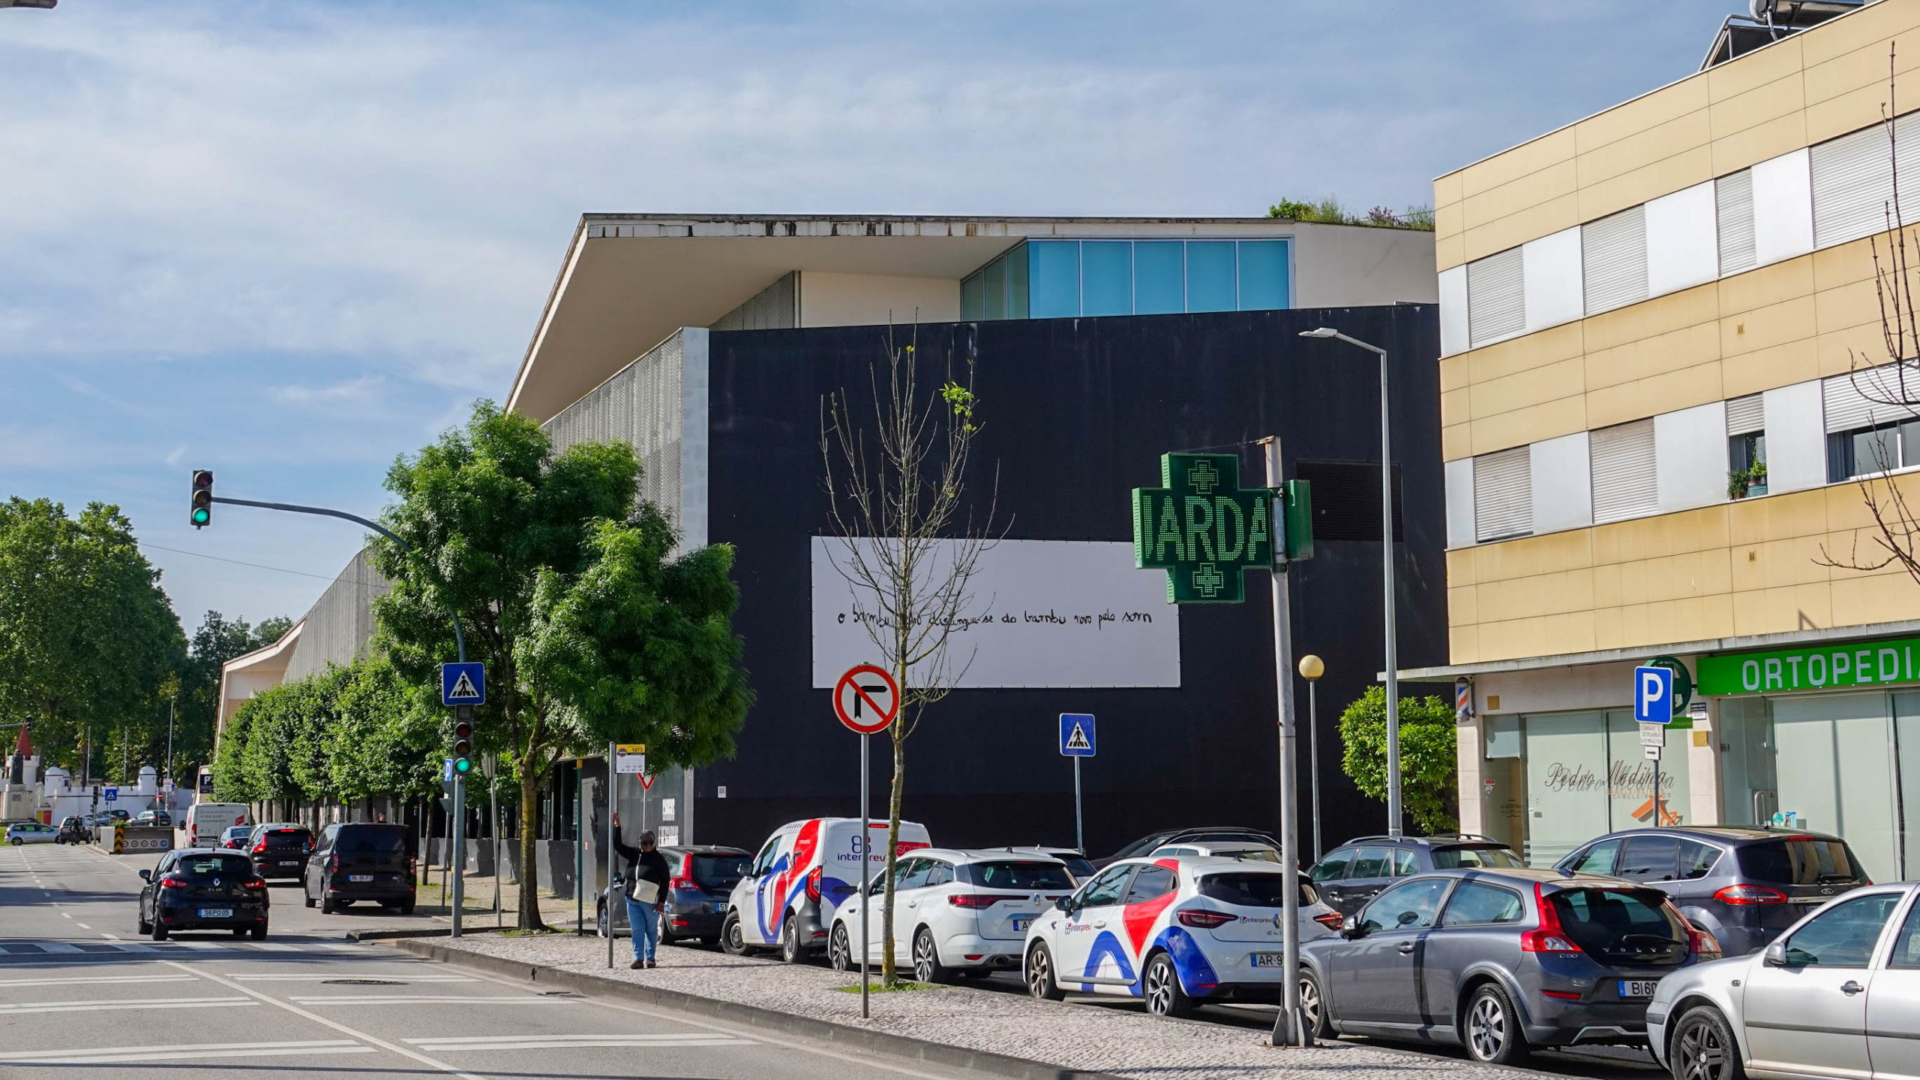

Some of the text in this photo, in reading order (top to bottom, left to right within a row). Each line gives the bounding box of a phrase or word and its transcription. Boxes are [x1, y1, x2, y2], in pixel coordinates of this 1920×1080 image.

[838, 613, 846, 624] o
[1001, 613, 1017, 624] do
[1098, 609, 1115, 630] pelo
[1122, 611, 1152, 624] som
[1742, 647, 1920, 691] ORTOPEDI
[1642, 672, 1664, 717] P
[1544, 760, 1667, 788] Pedro Medina
[838, 853, 886, 862] interrev
